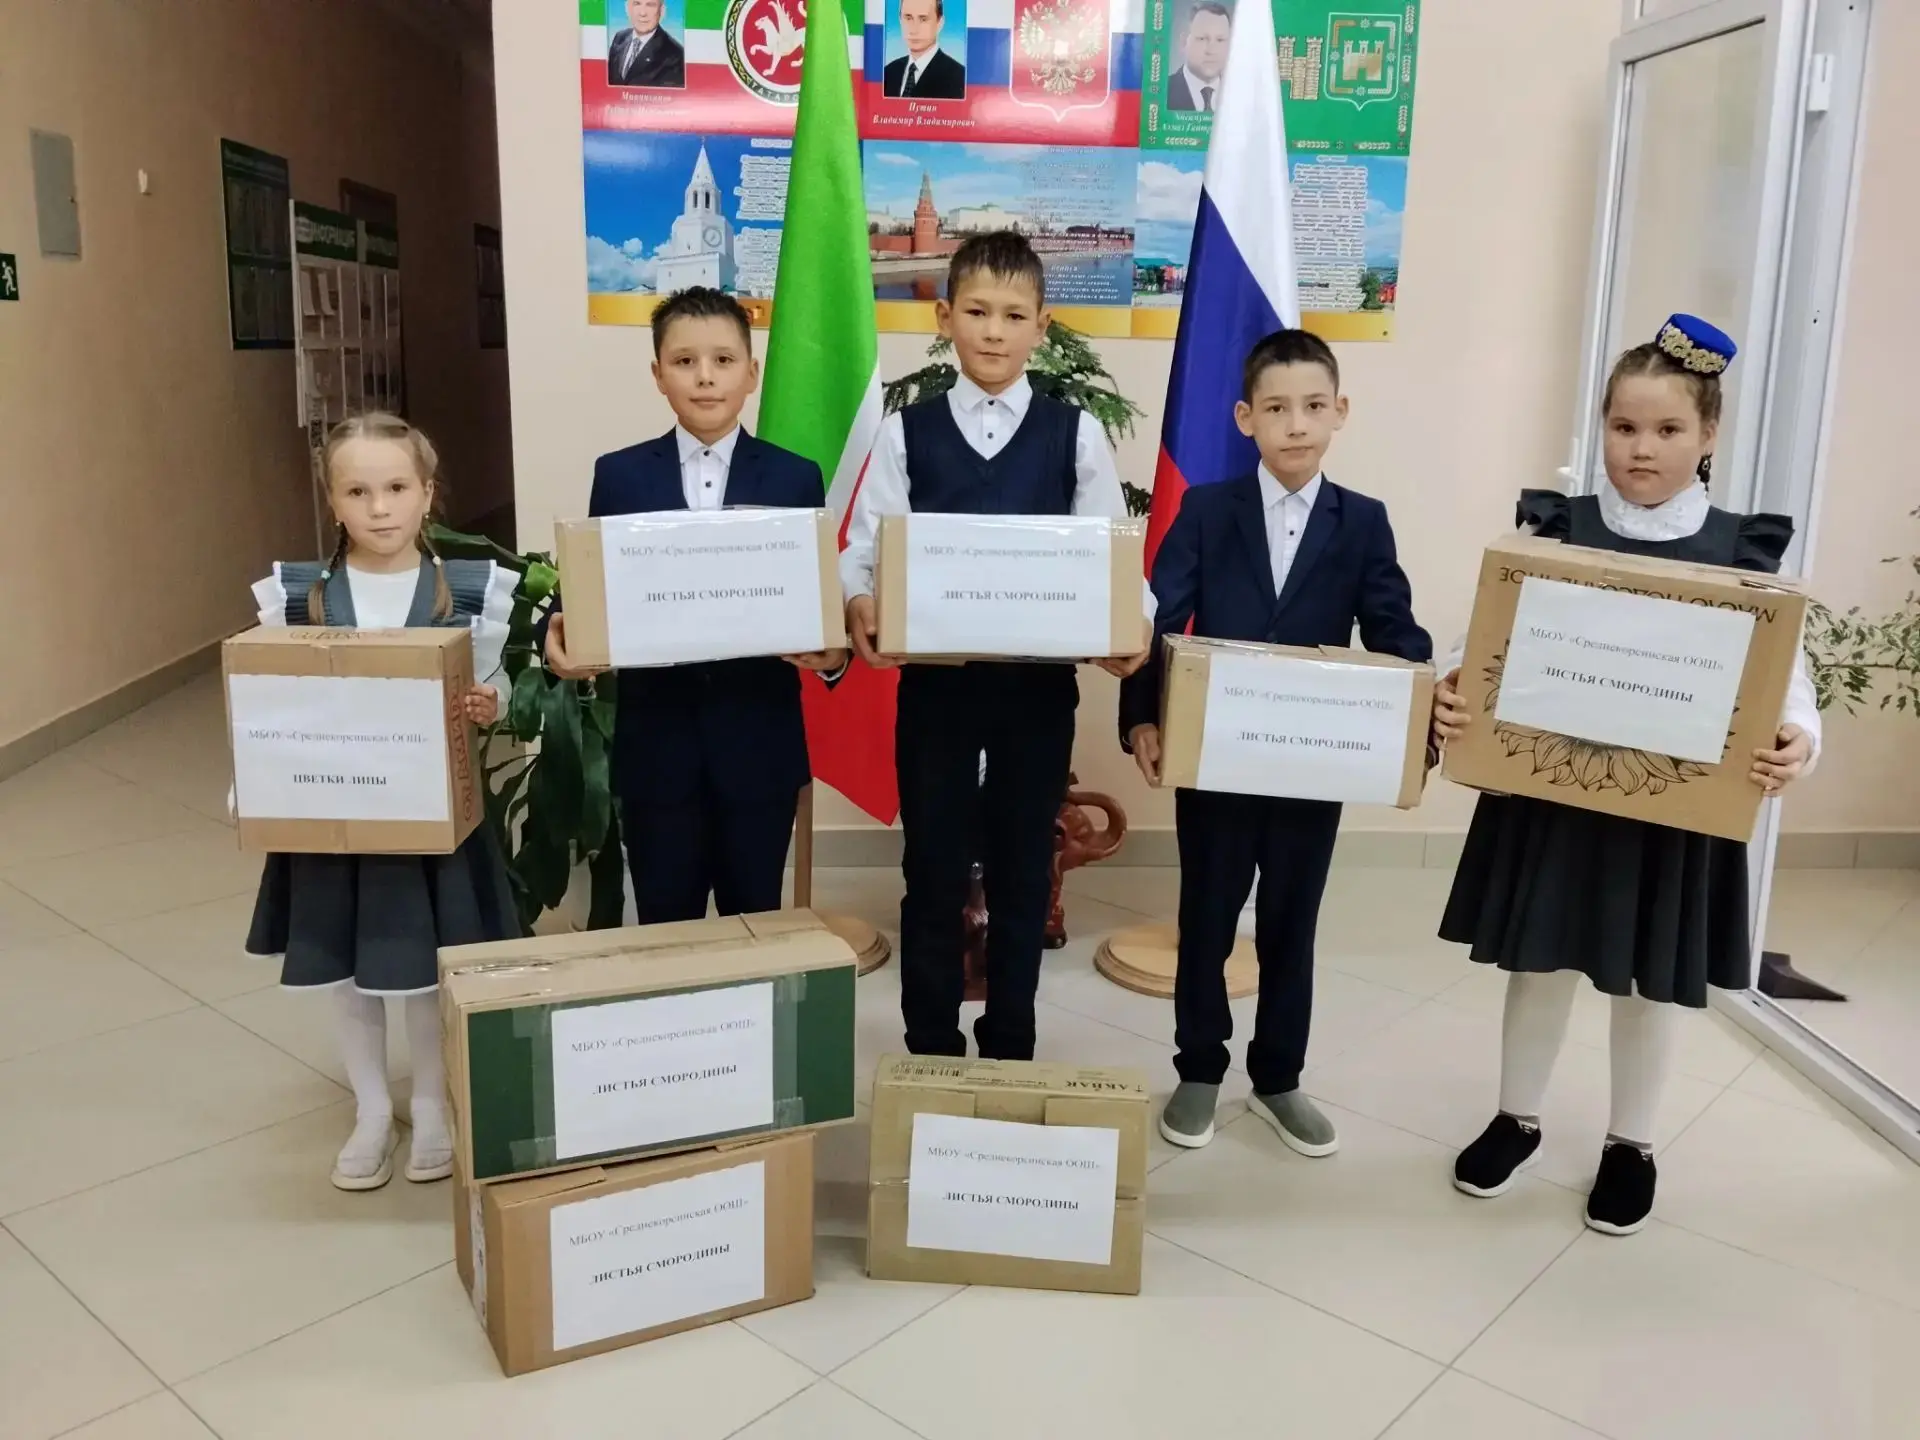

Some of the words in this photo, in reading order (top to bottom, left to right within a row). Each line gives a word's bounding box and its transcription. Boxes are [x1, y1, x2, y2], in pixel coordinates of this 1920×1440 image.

[909, 102, 937, 113] Путин
[873, 114, 914, 127] Владимир
[916, 115, 976, 128] Владимирович
[620, 546, 658, 557] МБОУ
[924, 545, 957, 556] МБОУ
[644, 591, 696, 602] ЛИСТЬЯ
[699, 586, 784, 600] СМОРОДИНЫ
[941, 591, 991, 600] ЛИСТЬЯ
[995, 591, 1076, 601] СМОРОДИНЫ
[1529, 627, 1567, 642] МБОУ
[1224, 686, 1258, 697] МБОУ
[1540, 666, 1595, 686] ЛИСТЬЯ
[1599, 678, 1693, 703] СМОРОДИНЫ
[249, 731, 283, 740] МБОУ
[1237, 731, 1286, 743] ЛИСТЬЯ
[1290, 736, 1371, 751] СМОРОДИНЫ
[293, 774, 344, 785] ЦВЕТКИ
[349, 775, 386, 785] ЛИПЫ
[571, 1039, 609, 1053] МБОУ
[592, 1078, 647, 1096] ЛИСТЬЯ
[650, 1065, 737, 1087] СМОРОДИНЫ
[928, 1147, 961, 1158] МБОУ
[942, 1192, 993, 1203] ЛИСТЬЯ
[996, 1195, 1078, 1210] СМОРОДИНЫ
[569, 1231, 606, 1246] МБОУ
[589, 1265, 643, 1285] ЛИСТЬЯ
[646, 1244, 730, 1272] СМОРОДИНЫ
